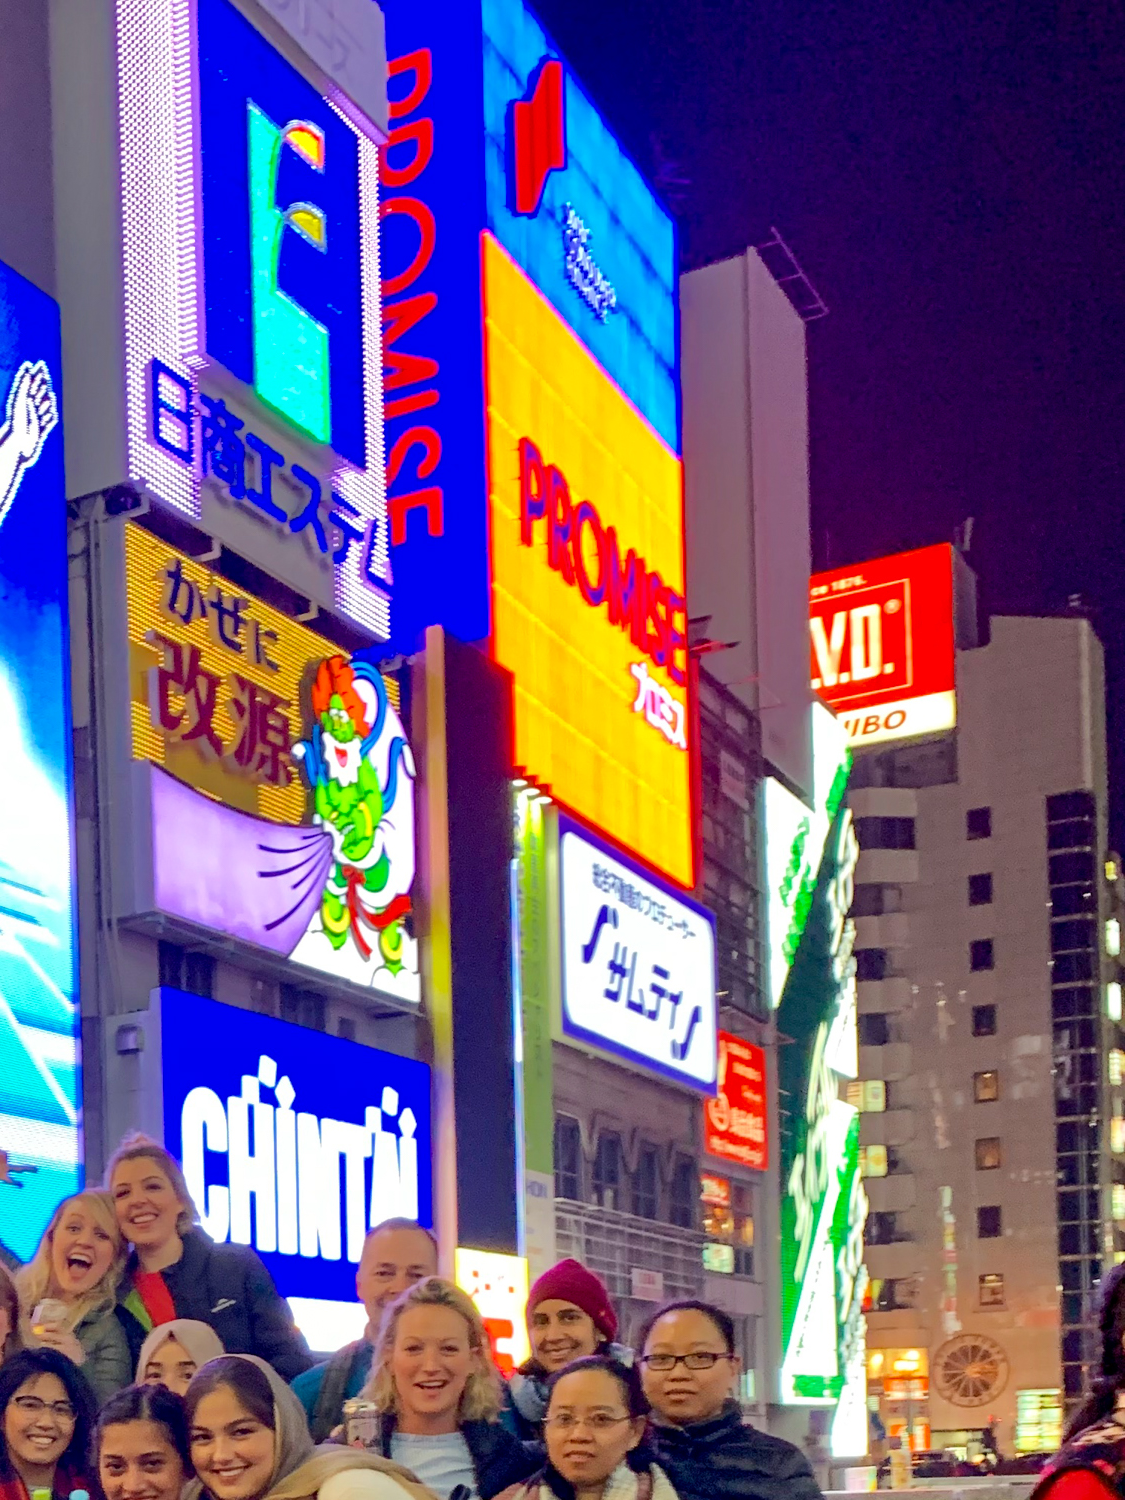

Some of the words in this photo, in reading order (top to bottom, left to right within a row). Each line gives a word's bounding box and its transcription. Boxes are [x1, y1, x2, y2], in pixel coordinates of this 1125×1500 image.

[517, 434, 687, 688] PROMISE
[810, 603, 895, 690] .V.D.
[157, 633, 294, 787] 改源
[843, 709, 907, 737] IBO
